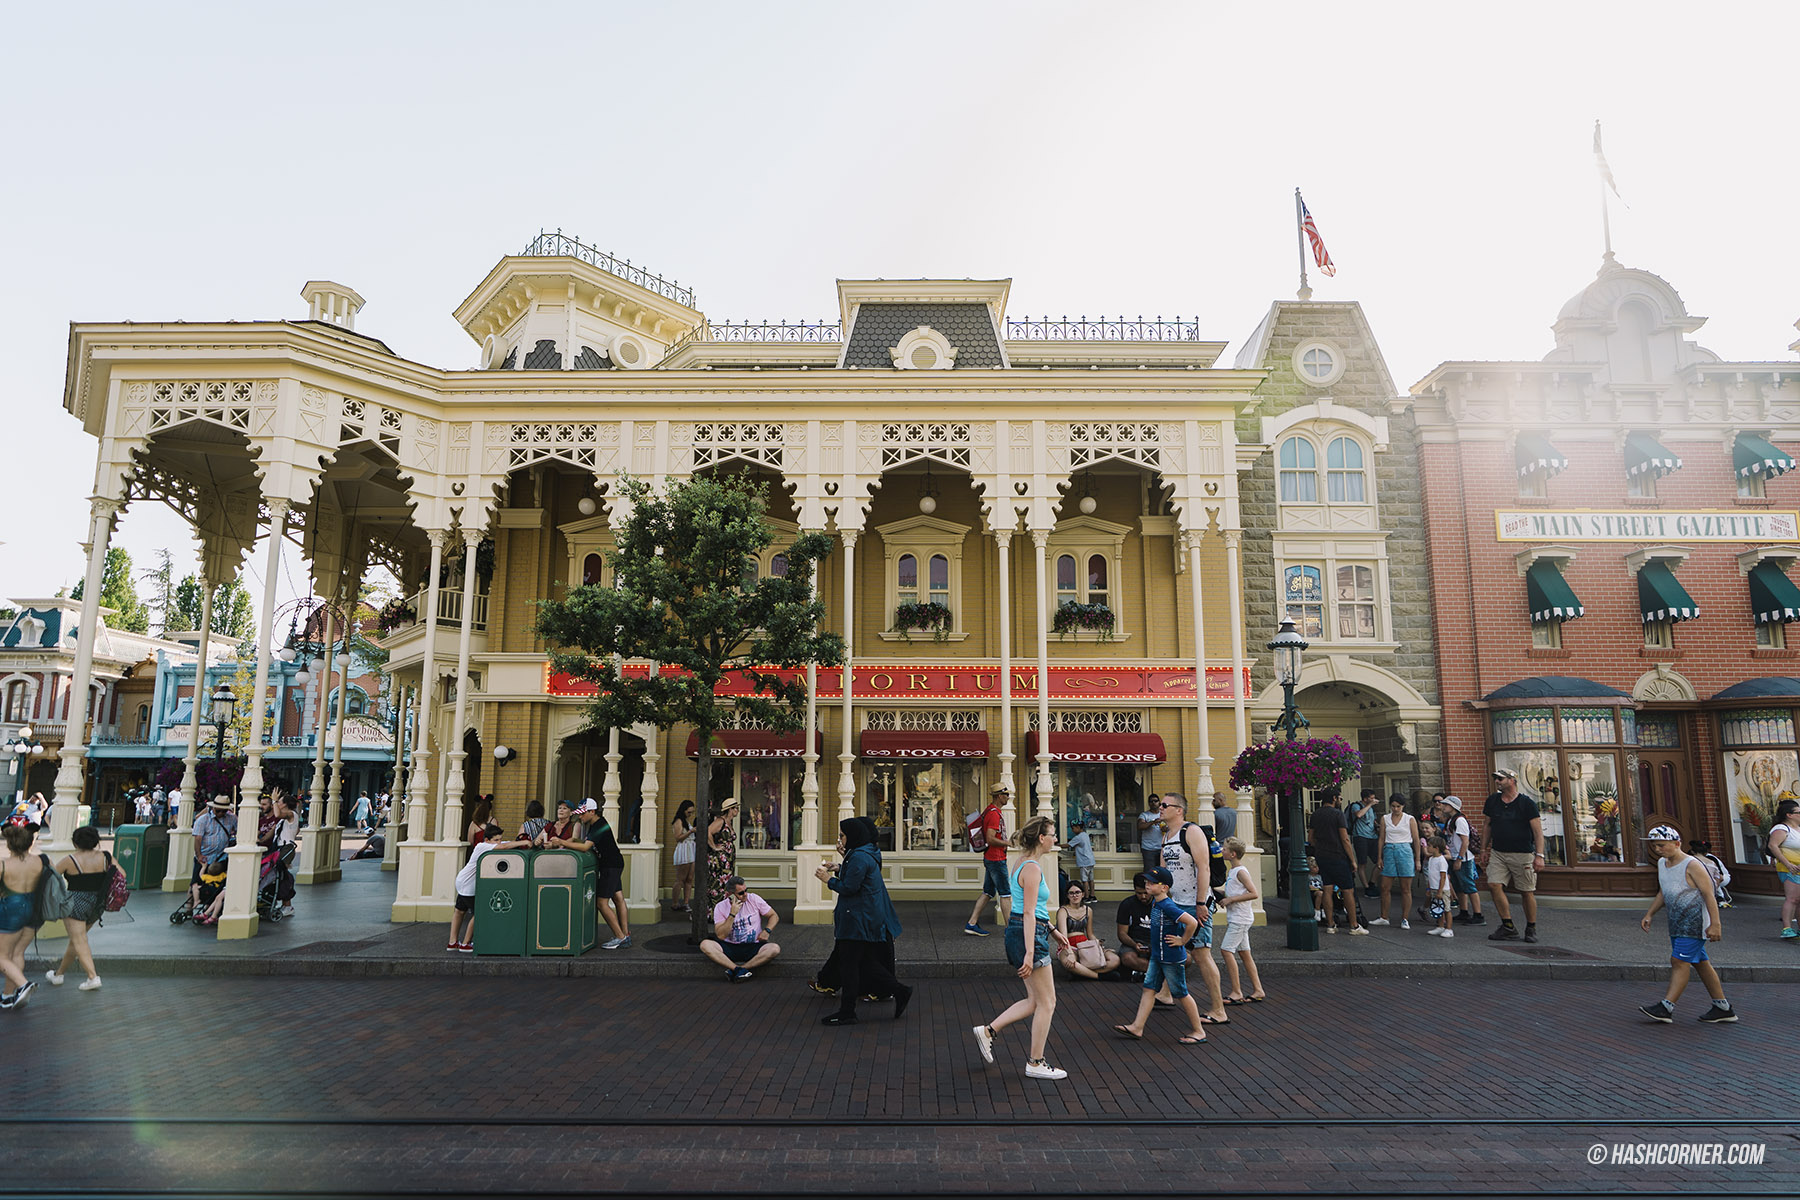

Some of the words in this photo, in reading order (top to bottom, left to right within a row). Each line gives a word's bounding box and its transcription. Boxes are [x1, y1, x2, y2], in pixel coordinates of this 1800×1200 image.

[1532, 515, 1583, 536] MAIN
[1591, 516, 1666, 536] STREET
[1677, 516, 1765, 537] GAZETTE
[340, 726, 381, 738] torybook
[896, 749, 956, 757] TOYS
[1050, 753, 1158, 761] NOTIONS
